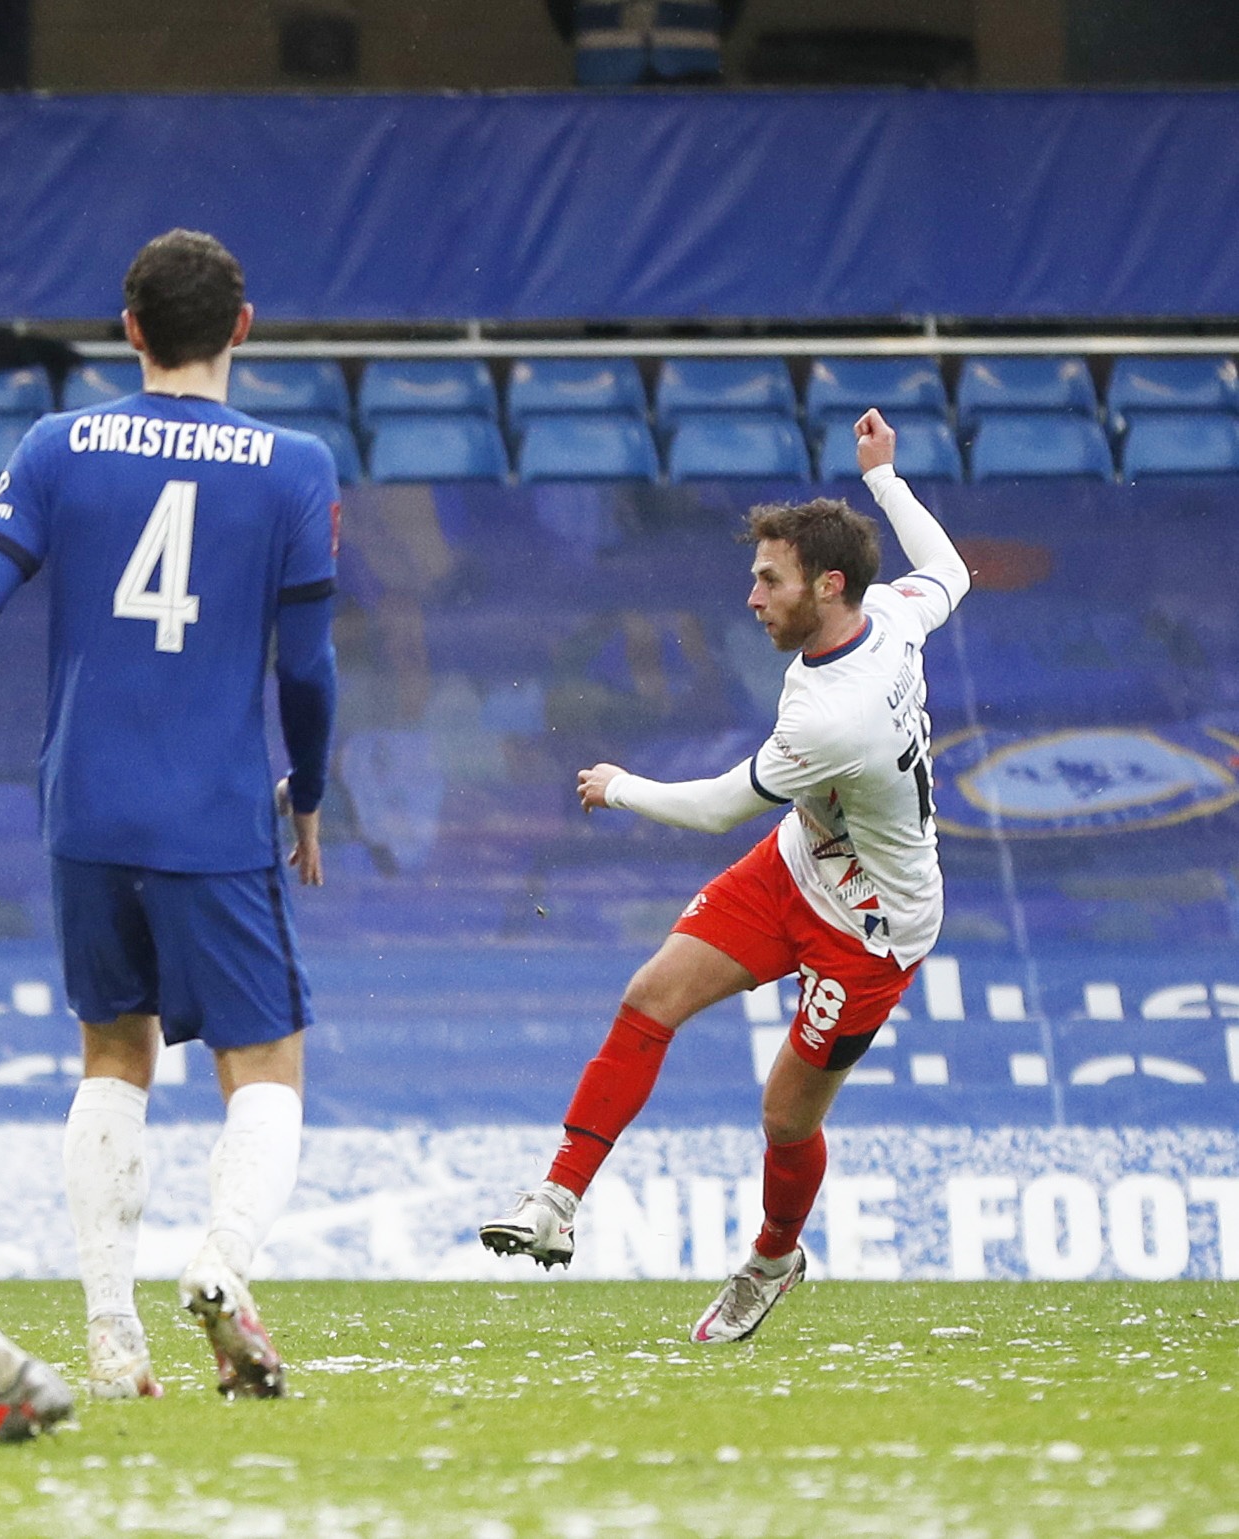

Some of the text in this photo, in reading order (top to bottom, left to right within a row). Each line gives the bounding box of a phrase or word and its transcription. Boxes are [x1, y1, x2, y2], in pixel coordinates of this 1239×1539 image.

[69, 413, 275, 467] CHRISTENSEN
[112, 479, 201, 654] 4
[799, 962, 848, 1032] 18
